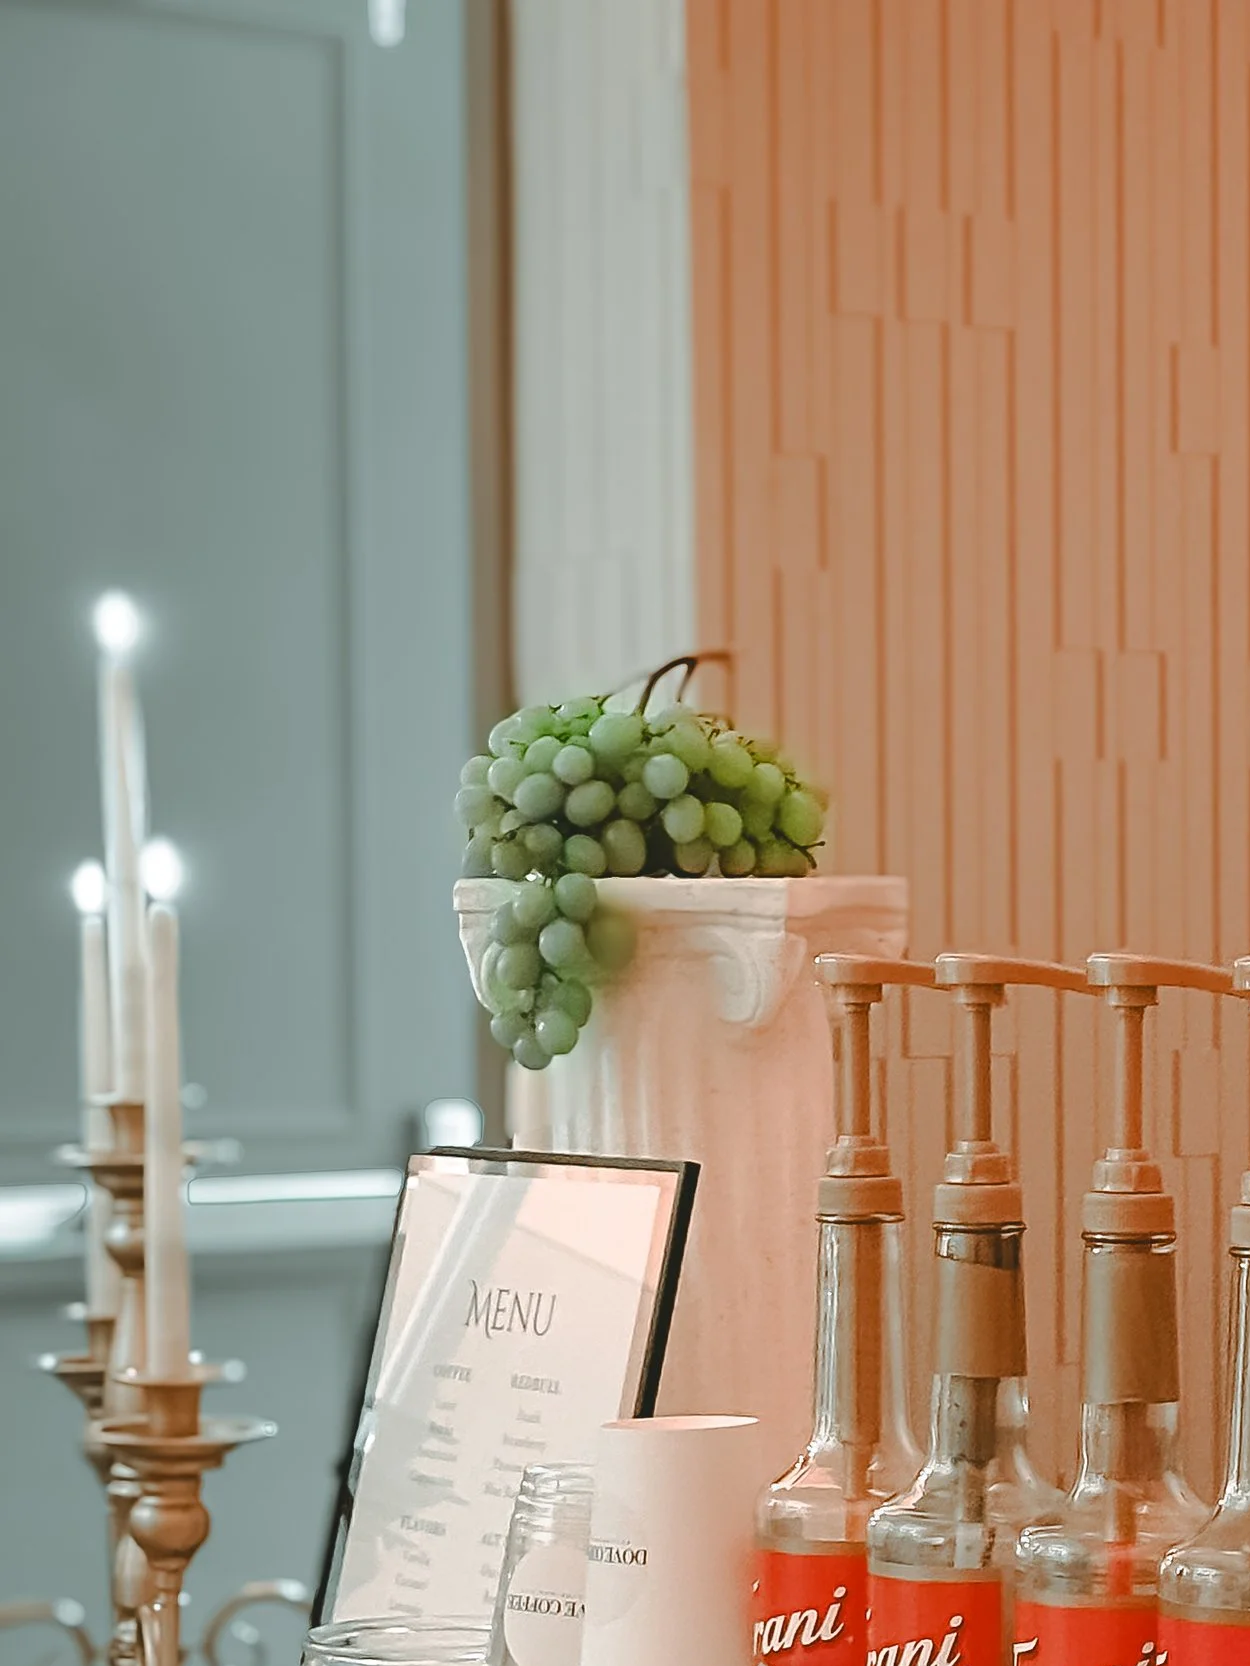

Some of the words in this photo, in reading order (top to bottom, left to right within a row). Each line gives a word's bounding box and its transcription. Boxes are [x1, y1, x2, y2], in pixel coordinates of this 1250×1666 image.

[465, 1279, 557, 1340] MENU
[564, 1601, 586, 1618] VE
[753, 1586, 847, 1656] rani
